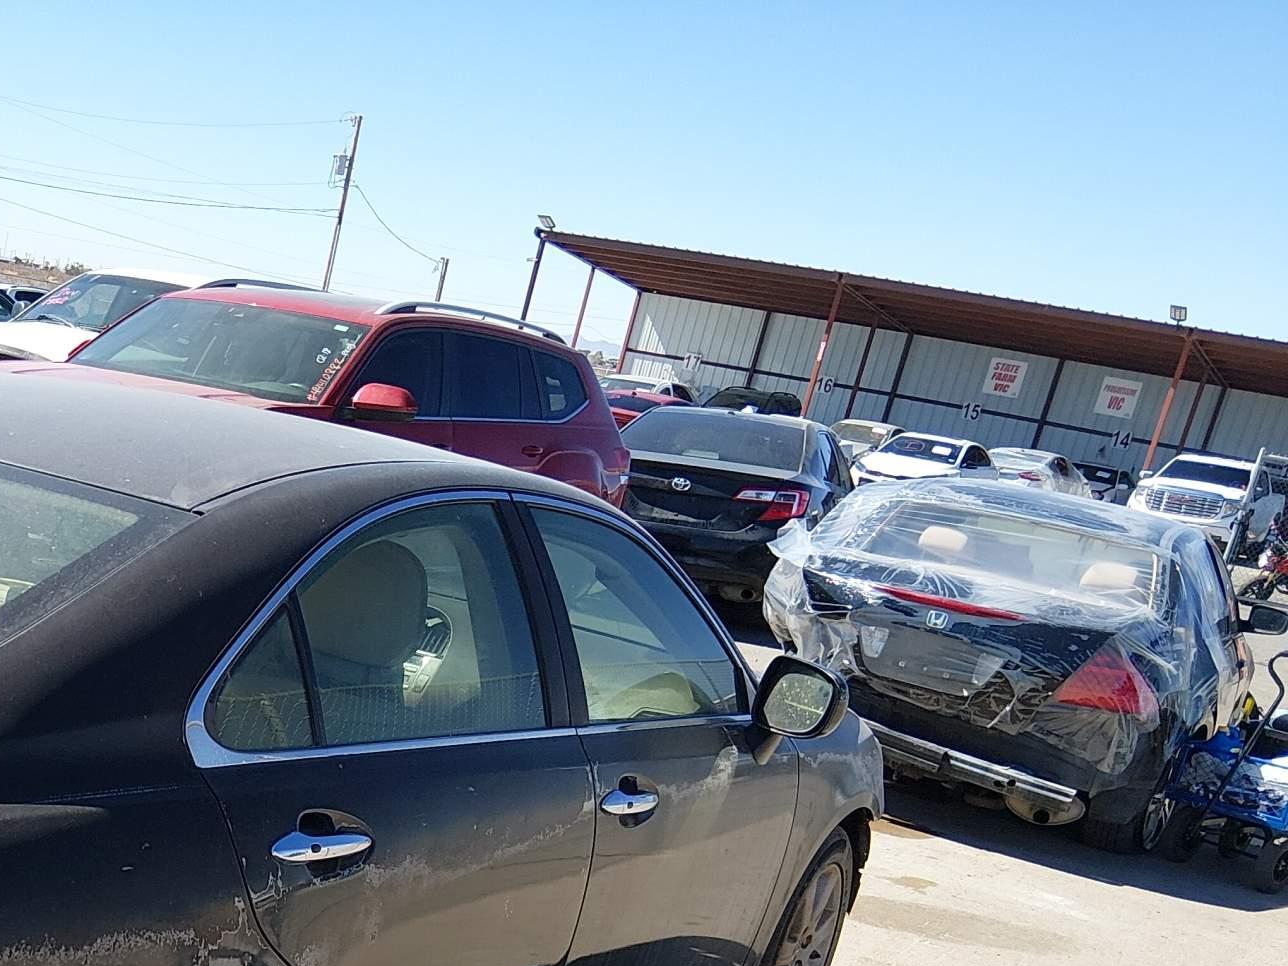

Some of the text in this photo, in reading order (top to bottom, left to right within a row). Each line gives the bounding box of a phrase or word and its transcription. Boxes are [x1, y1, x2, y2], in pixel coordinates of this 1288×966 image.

[685, 354, 701, 370] 17
[993, 362, 1021, 374] STATE
[817, 377, 833, 393] 16
[991, 372, 1018, 384] FARM
[993, 382, 1010, 393] VIC
[962, 402, 981, 420] 15
[1107, 395, 1125, 411] VIC
[1112, 431, 1130, 448] 14
